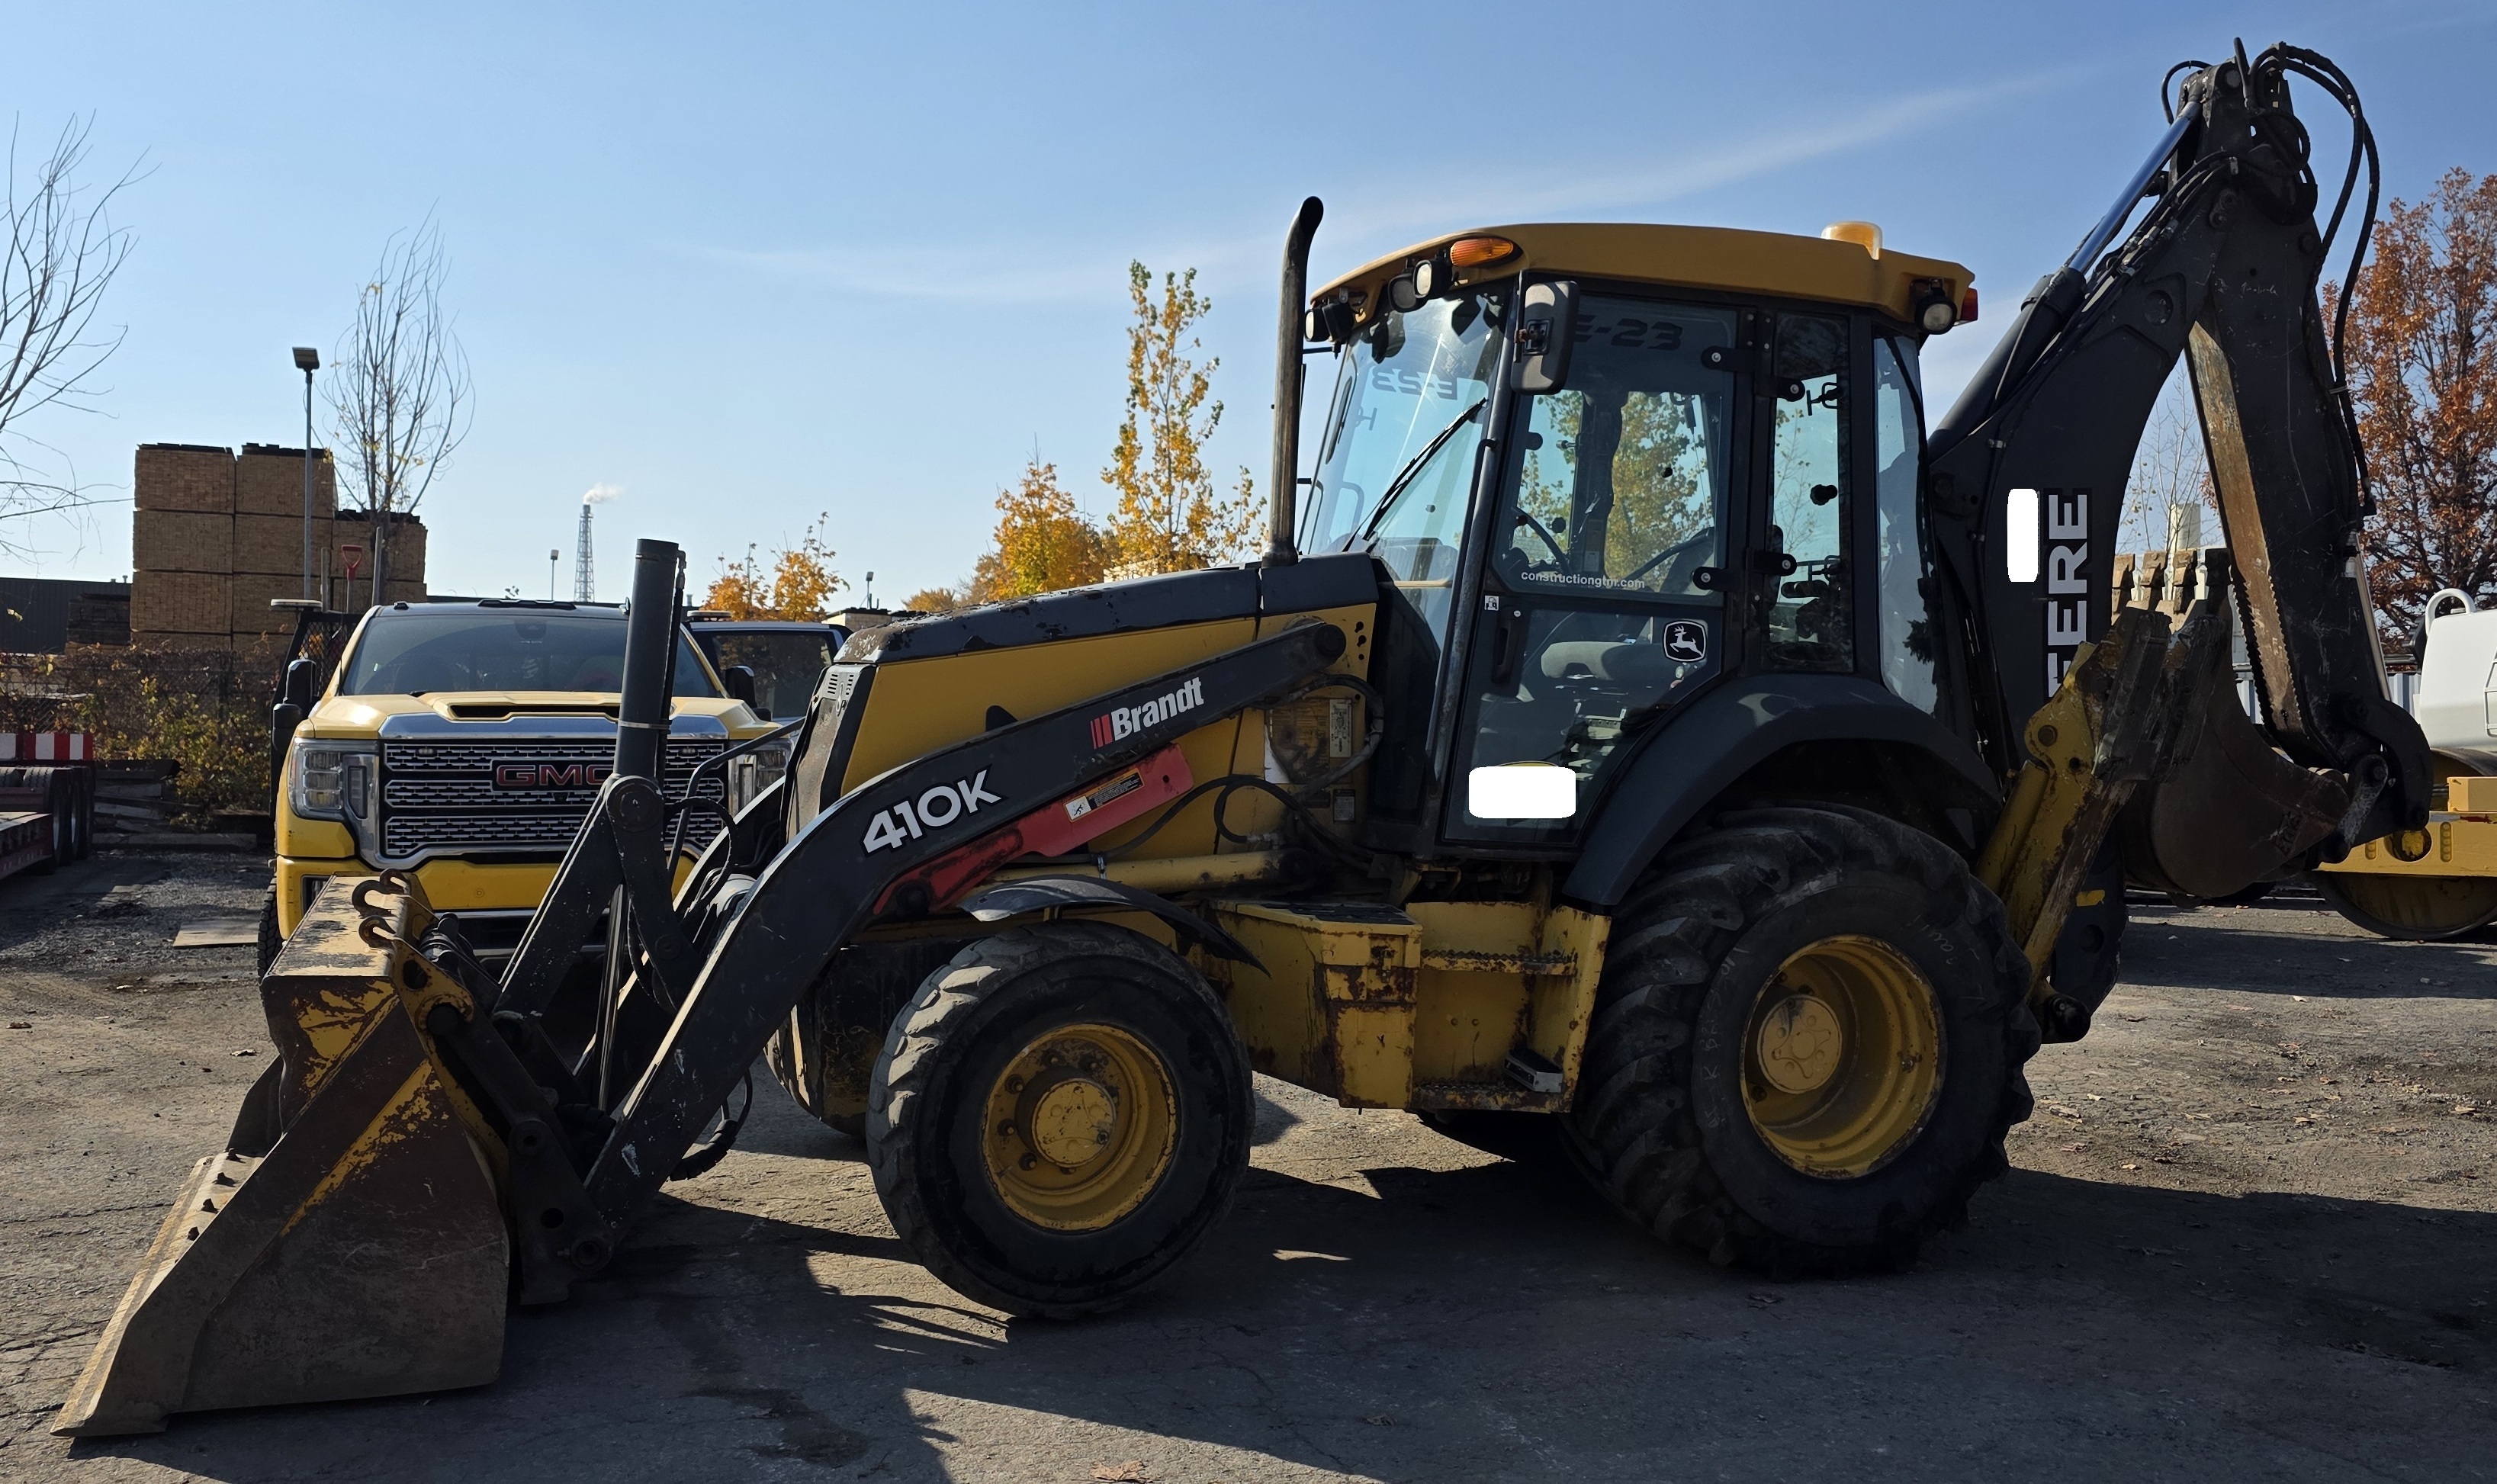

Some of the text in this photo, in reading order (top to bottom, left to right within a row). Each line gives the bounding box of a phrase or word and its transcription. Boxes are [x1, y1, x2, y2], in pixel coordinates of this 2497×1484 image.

[1521, 572, 1645, 589] constructiongtm.com
[1110, 676, 1204, 741] Brandt
[497, 765, 614, 786] GMC
[863, 769, 1002, 853] 410K
